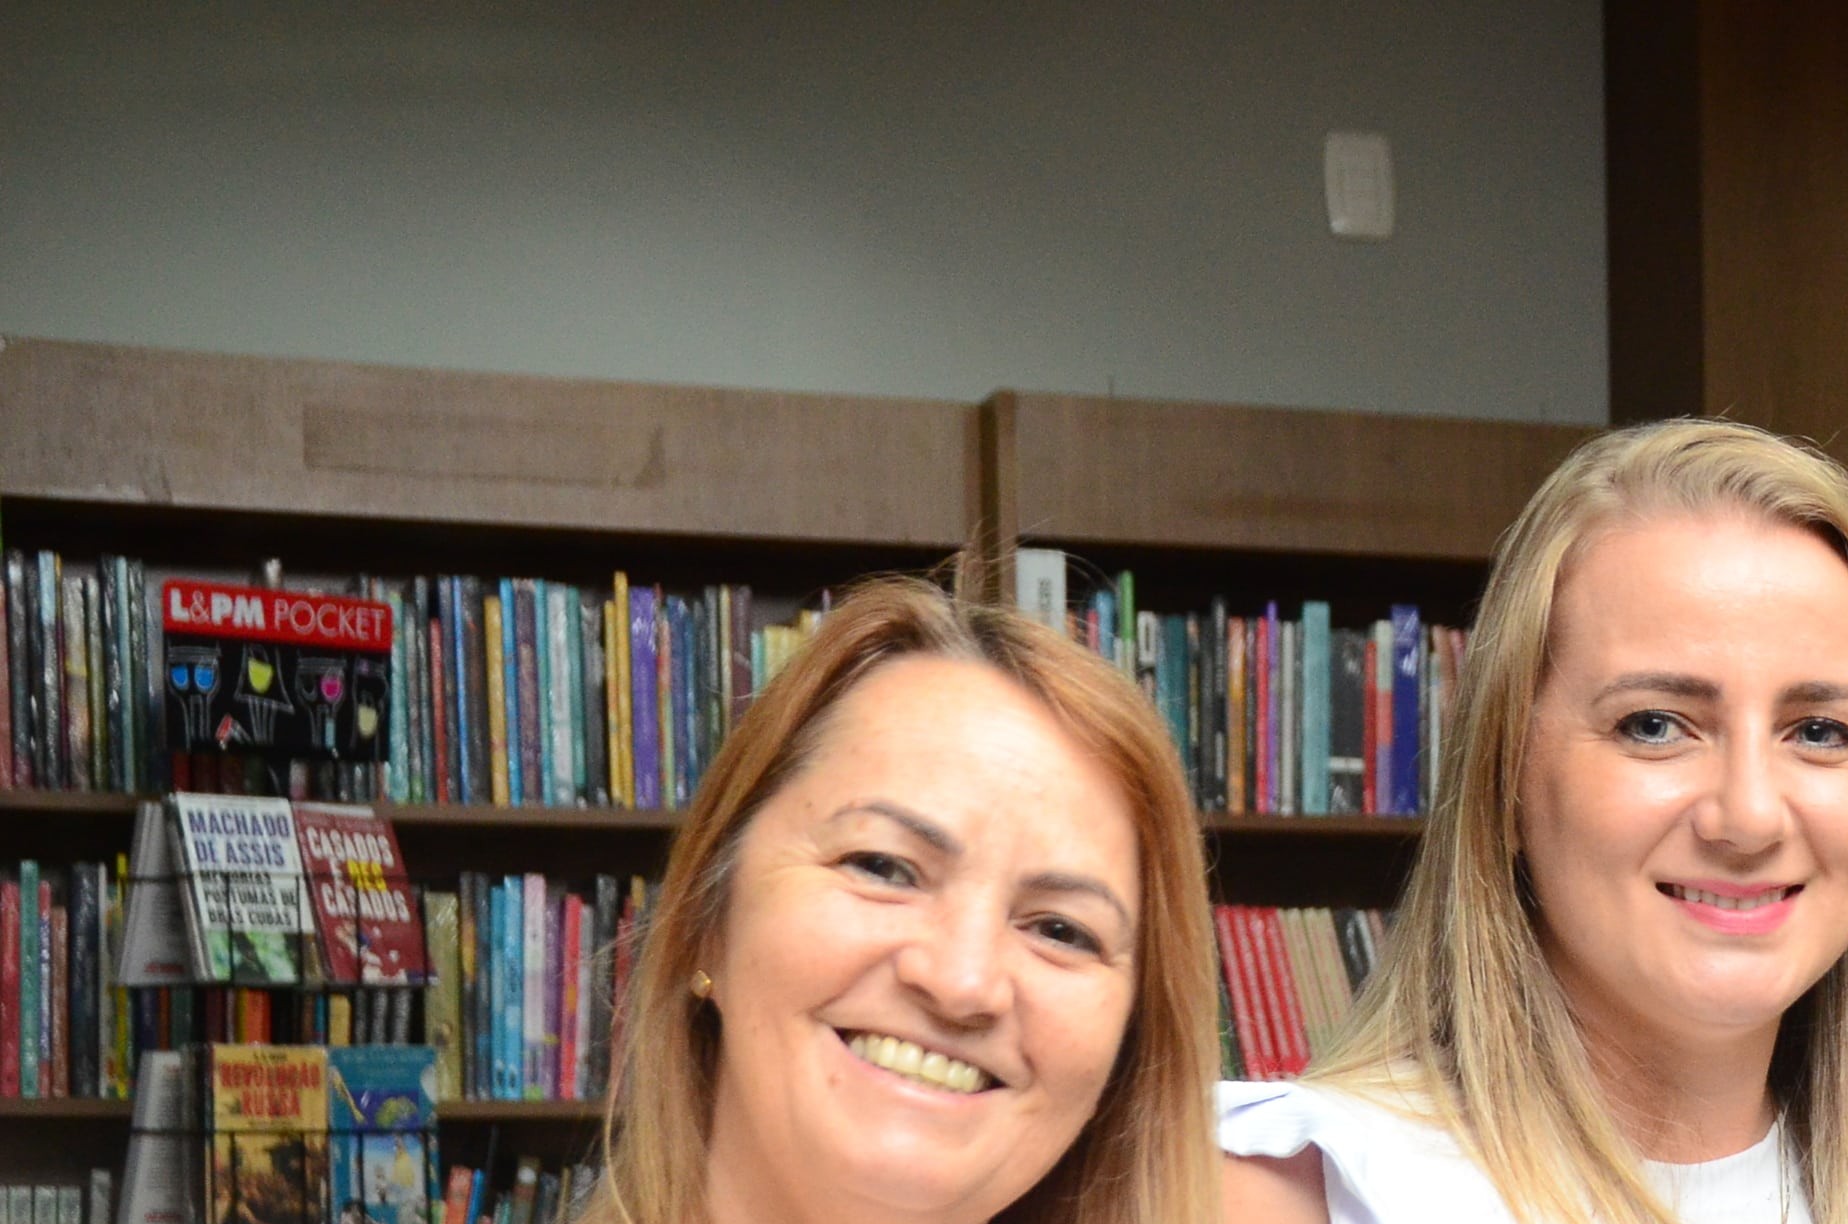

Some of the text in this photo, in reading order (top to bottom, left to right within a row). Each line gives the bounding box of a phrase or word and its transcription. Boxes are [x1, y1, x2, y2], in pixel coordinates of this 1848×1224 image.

[170, 588, 386, 641] L&PM POCKET
[187, 810, 290, 838] MACHADO
[194, 840, 286, 868] DE ASSIS
[306, 826, 395, 868] CASADOS
[347, 859, 387, 892] DES
[248, 909, 292, 926] CUBAS
[321, 883, 411, 923] CASADOS
